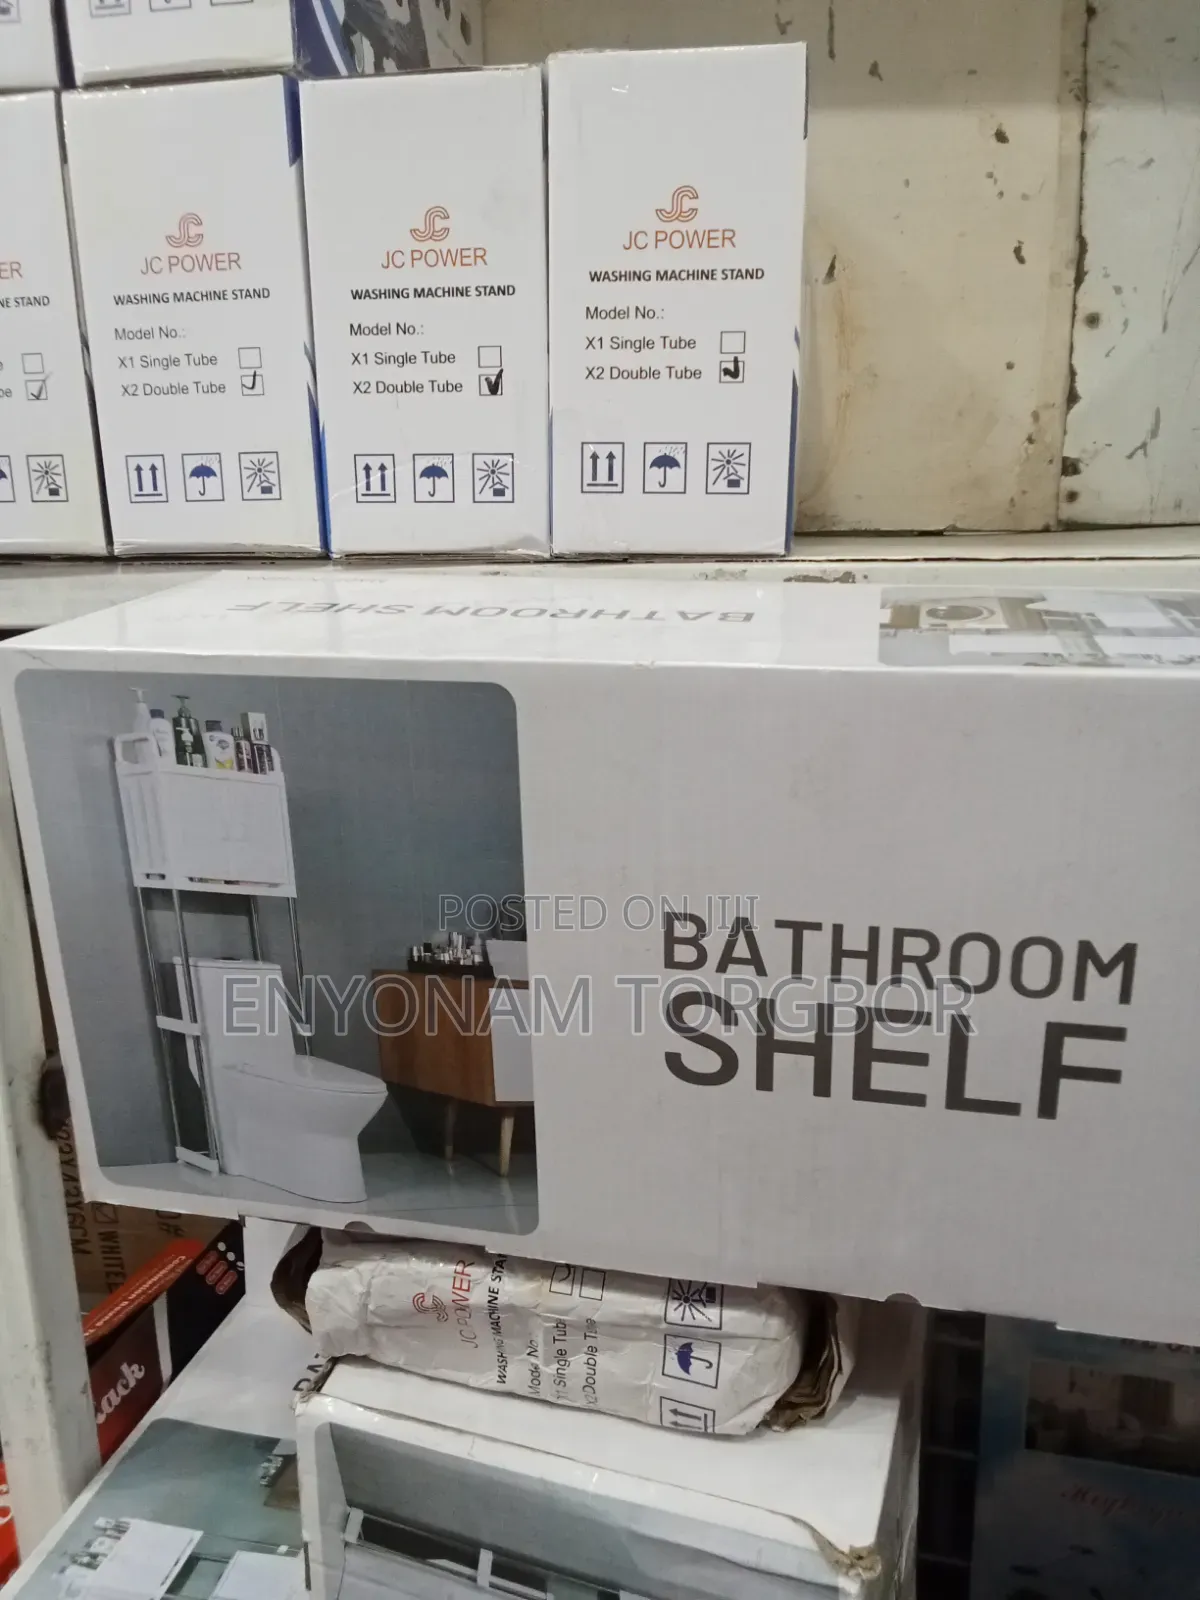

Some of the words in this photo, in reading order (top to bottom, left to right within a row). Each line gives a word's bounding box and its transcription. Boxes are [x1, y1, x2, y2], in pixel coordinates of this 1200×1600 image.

[623, 231, 648, 251] JC
[655, 229, 736, 250] POWER
[140, 257, 163, 275] JC
[169, 252, 242, 273] POWER
[381, 250, 405, 269] JC
[411, 247, 488, 268] POWER
[589, 270, 652, 283] WASHING
[656, 269, 718, 282] MACHINE
[721, 267, 765, 280] STAND
[113, 291, 169, 306] WASHING
[172, 288, 228, 303] MACHINE
[231, 287, 271, 300] STAND
[351, 287, 410, 301] WASHING
[413, 286, 472, 299] MACHINE
[475, 284, 516, 297] STAND
[14, 295, 50, 308] STAND
[585, 306, 630, 320] Model
[634, 306, 665, 320] No.:
[114, 326, 154, 340] Model
[350, 322, 392, 336] Model
[396, 322, 424, 336] No.:
[585, 337, 604, 350] X1
[609, 336, 656, 352] Single
[660, 336, 696, 350] Tube
[118, 355, 137, 369] X1
[140, 354, 181, 370] Single
[184, 353, 218, 367] Tube
[351, 352, 370, 365] X1
[374, 351, 417, 367] Single
[421, 350, 456, 364] Tube
[585, 367, 605, 380] X2
[609, 365, 661, 380] Double
[665, 365, 702, 380] Tube
[121, 383, 139, 397] X2
[143, 382, 189, 396] Double
[193, 381, 226, 395] Tube
[353, 381, 372, 394] X2
[376, 380, 424, 394] Double
[428, 379, 463, 393] Tube
[227, 601, 414, 614] SHELF
[424, 604, 755, 623] BATHROOM
[663, 911, 1138, 1005] BATHROOM
[664, 991, 1127, 1120] SHELF
[487, 1286, 504, 1337] MACHINE
[553, 1348, 571, 1388] Single
[581, 1345, 598, 1395] Double
[96, 1362, 145, 1424] ack
